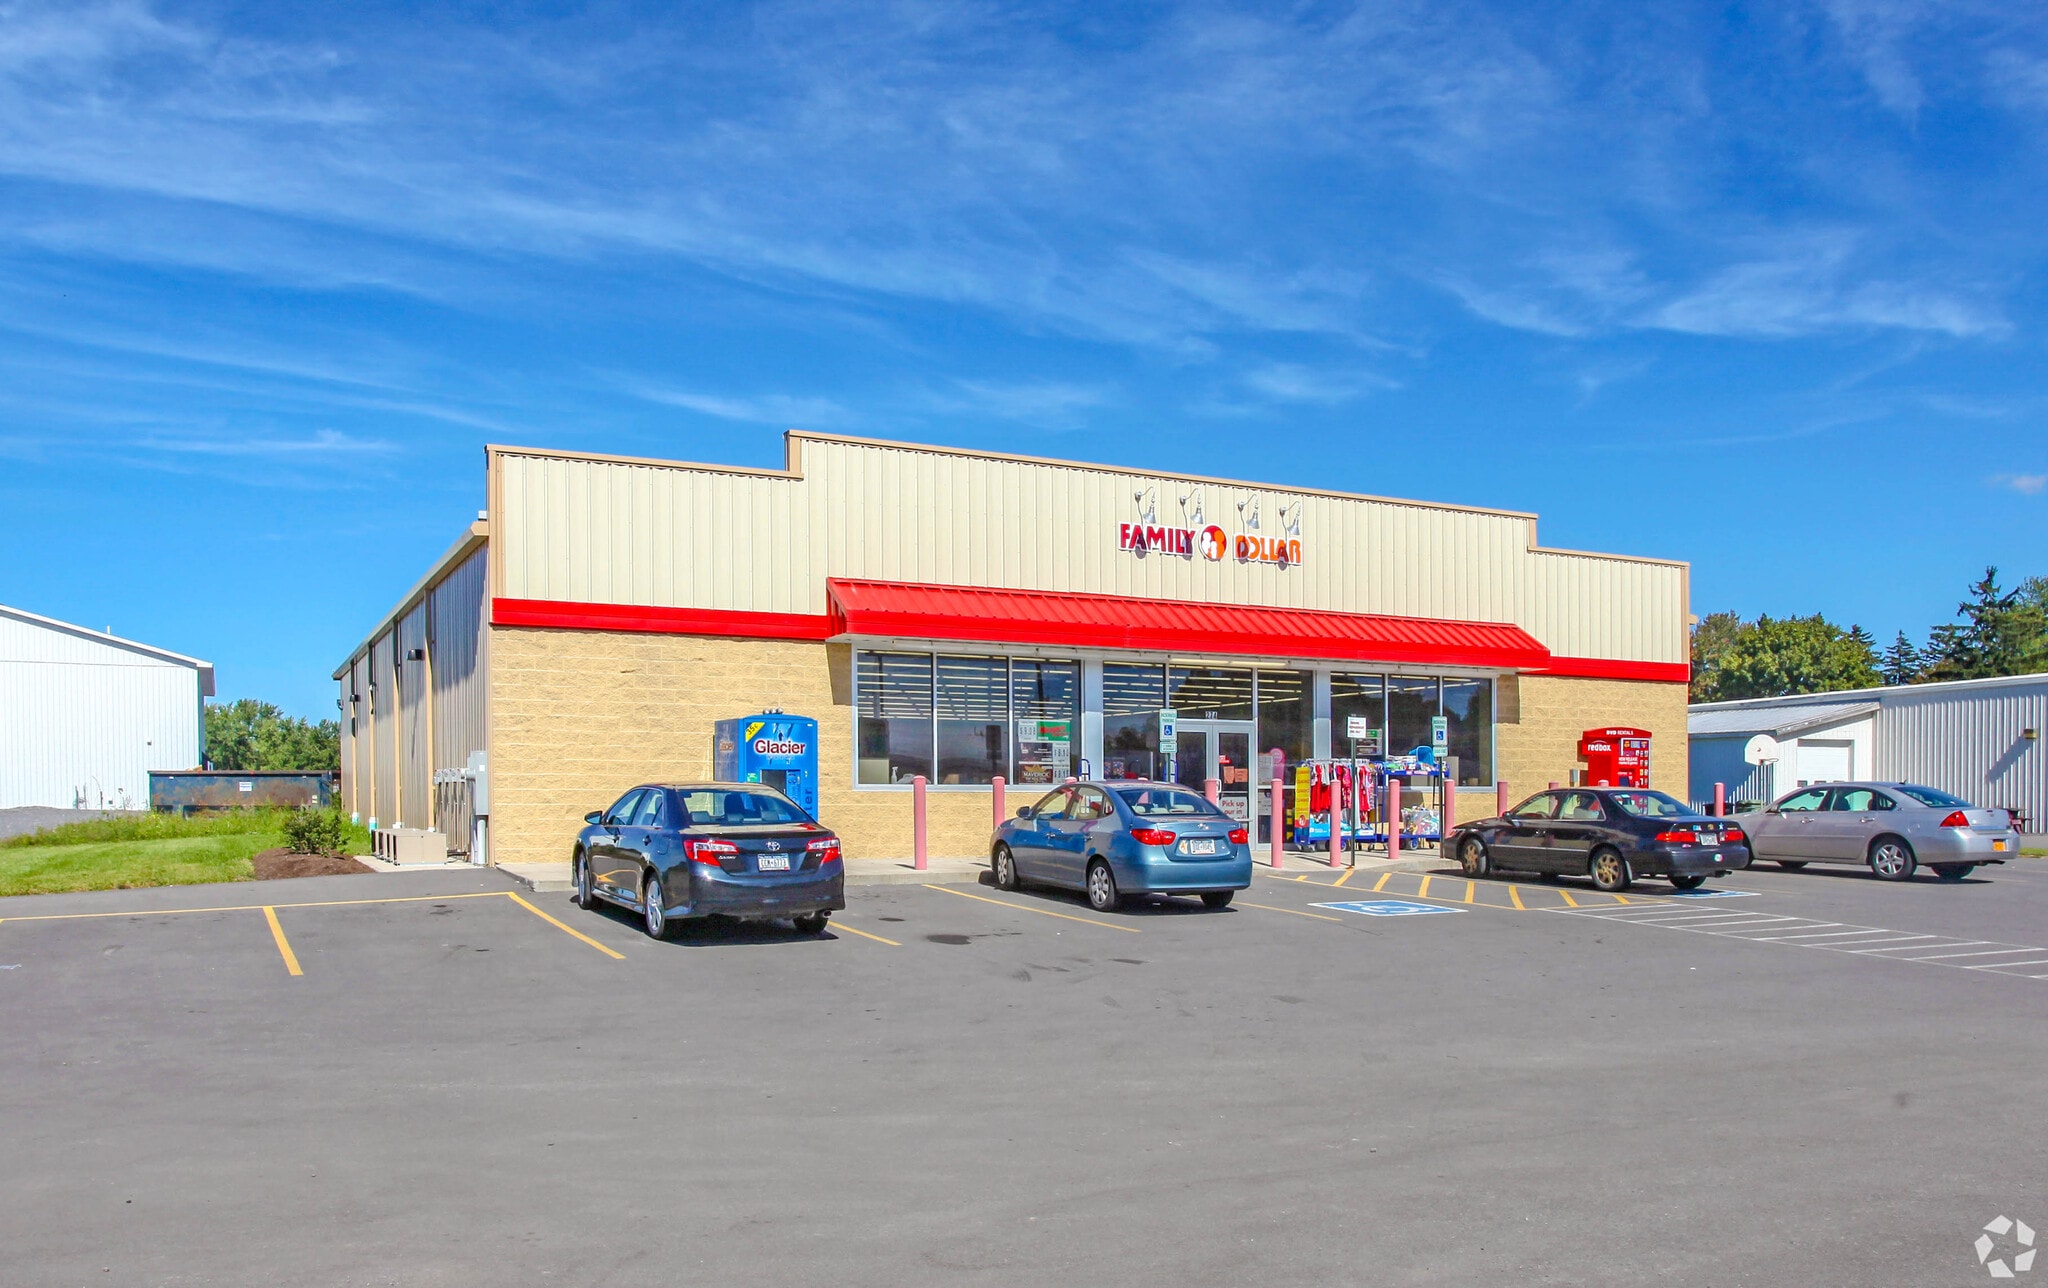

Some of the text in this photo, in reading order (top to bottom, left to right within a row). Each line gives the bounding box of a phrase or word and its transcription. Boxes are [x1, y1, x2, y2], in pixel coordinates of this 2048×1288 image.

[1120, 524, 1301, 563] FAMILY DOLLAR
[755, 740, 806, 754] Glacier
